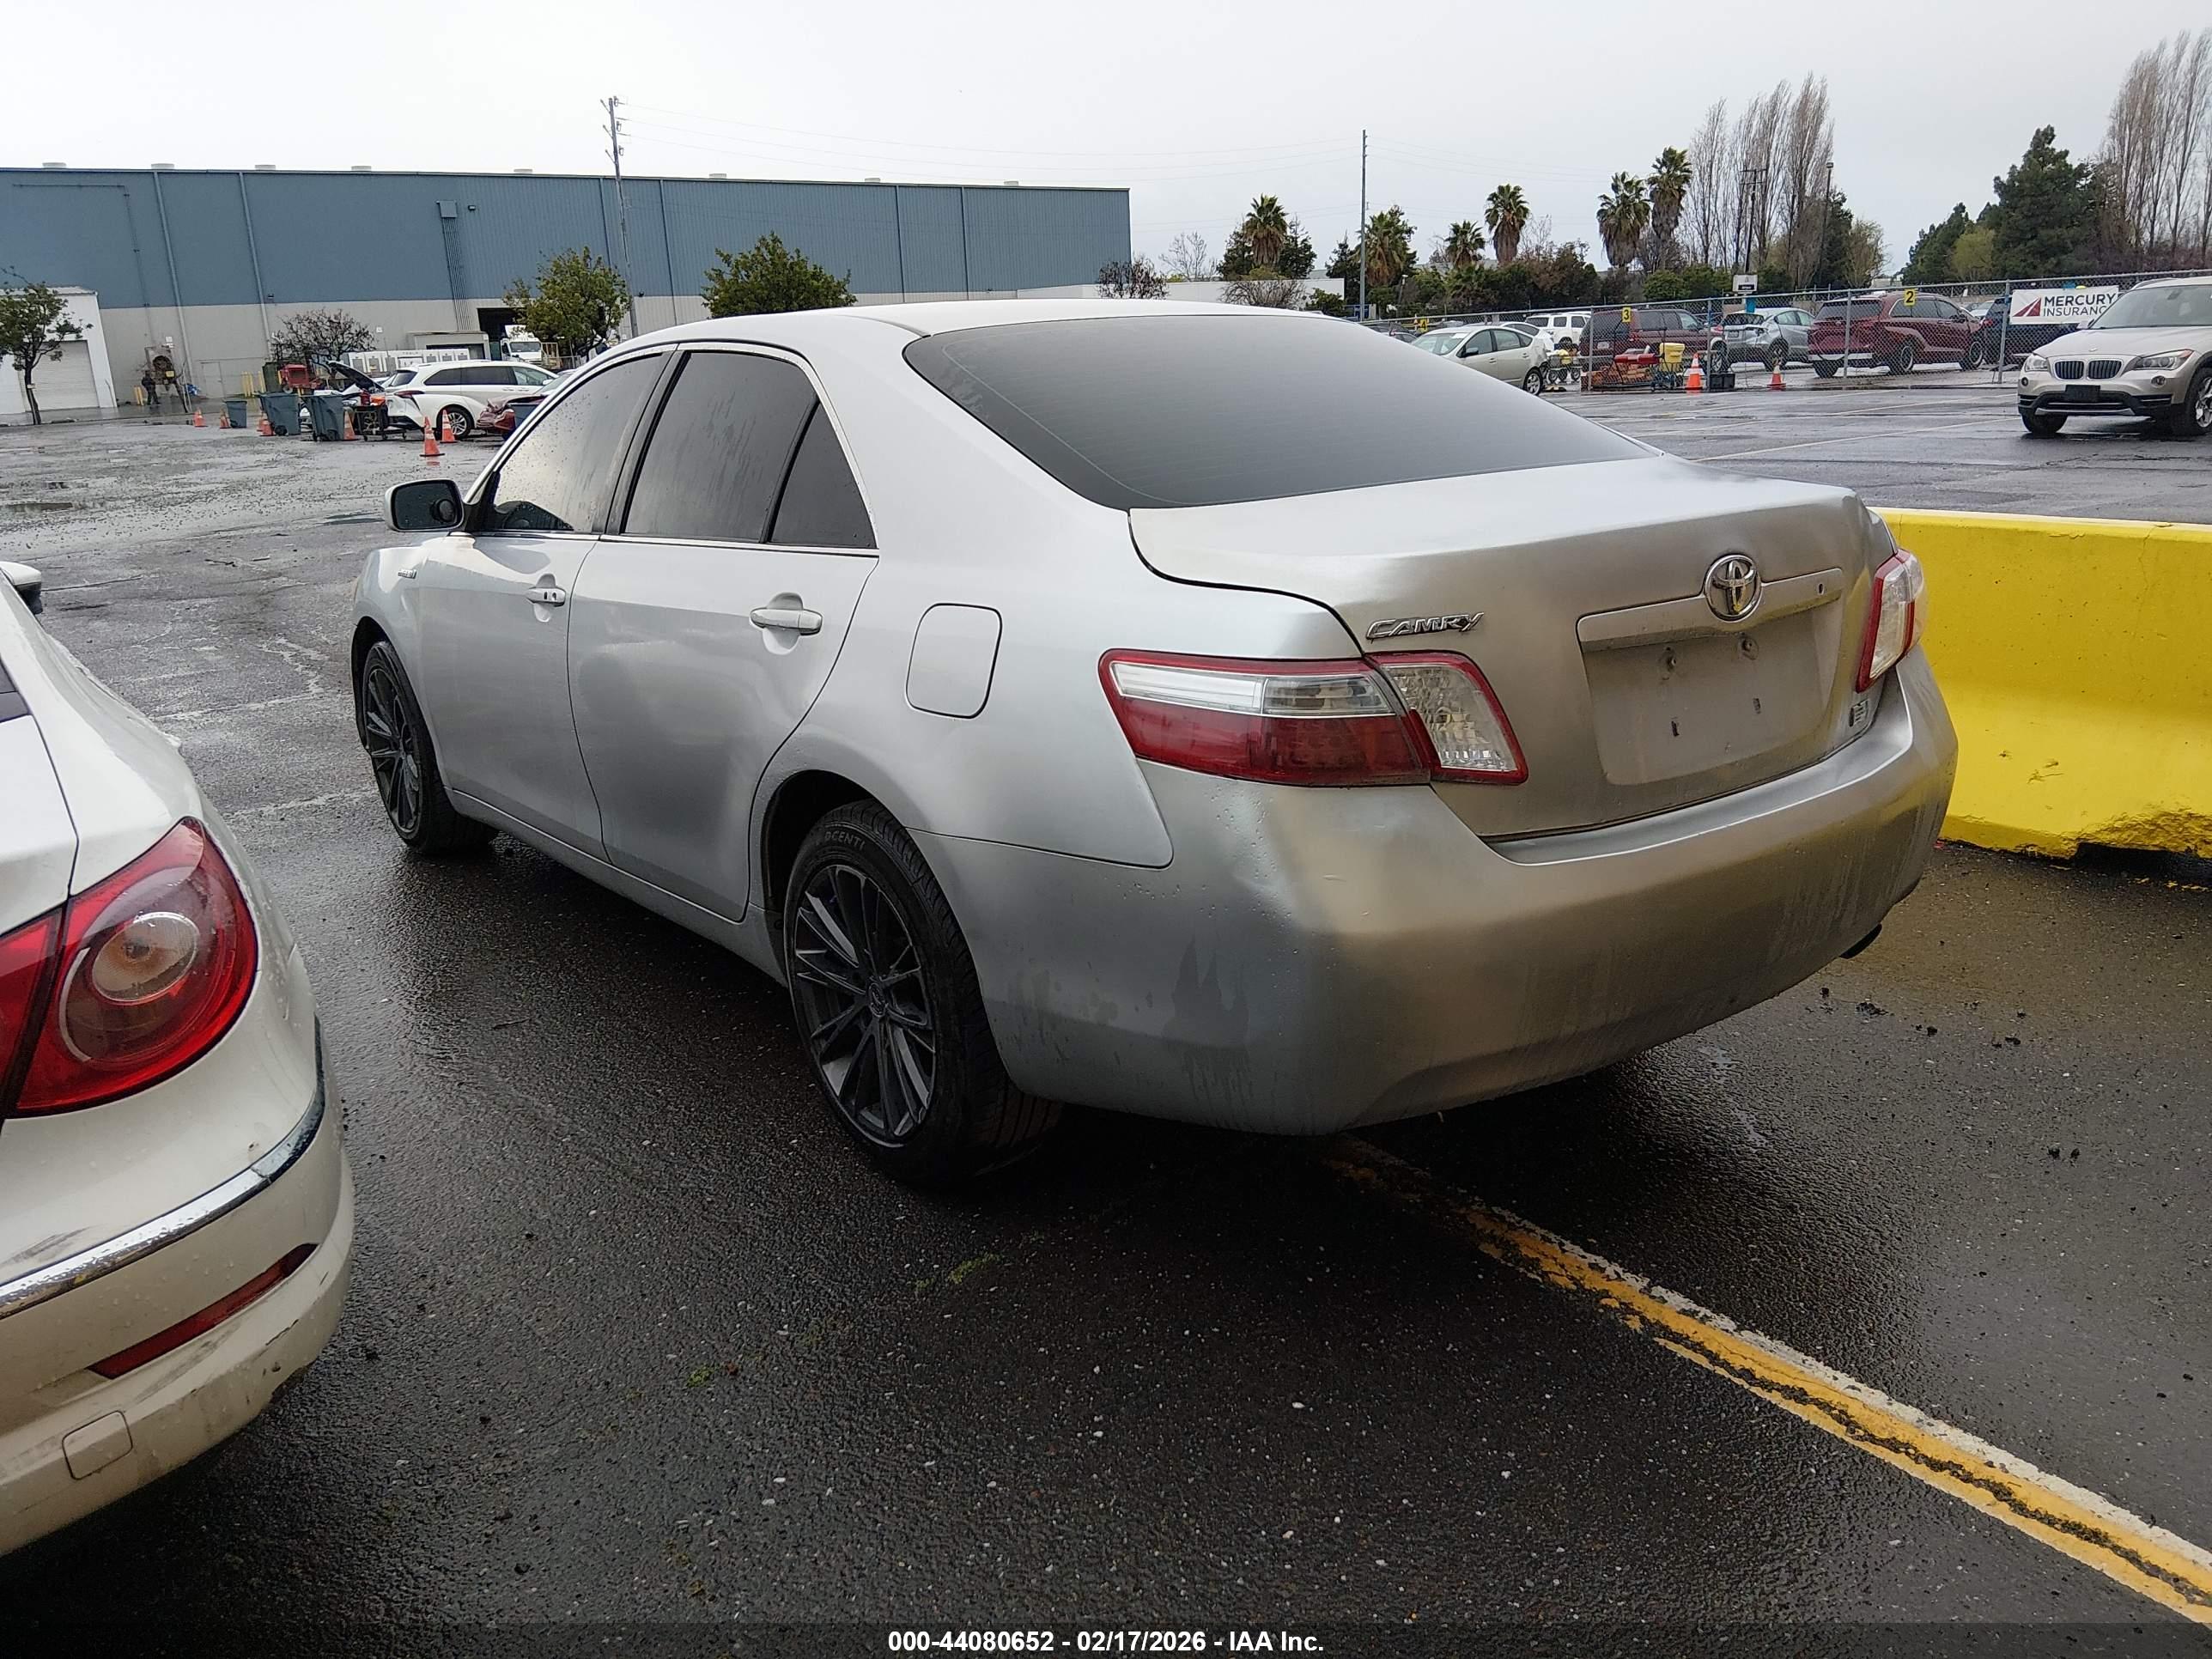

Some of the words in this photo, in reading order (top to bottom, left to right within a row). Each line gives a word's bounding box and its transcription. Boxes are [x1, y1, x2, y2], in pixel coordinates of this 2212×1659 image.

[1905, 290, 1914, 303] 2
[2044, 293, 2116, 307] MERCURY
[1623, 309, 1630, 320] 3
[2044, 305, 2107, 317] INSURANC
[1365, 611, 1485, 640] CAMRY
